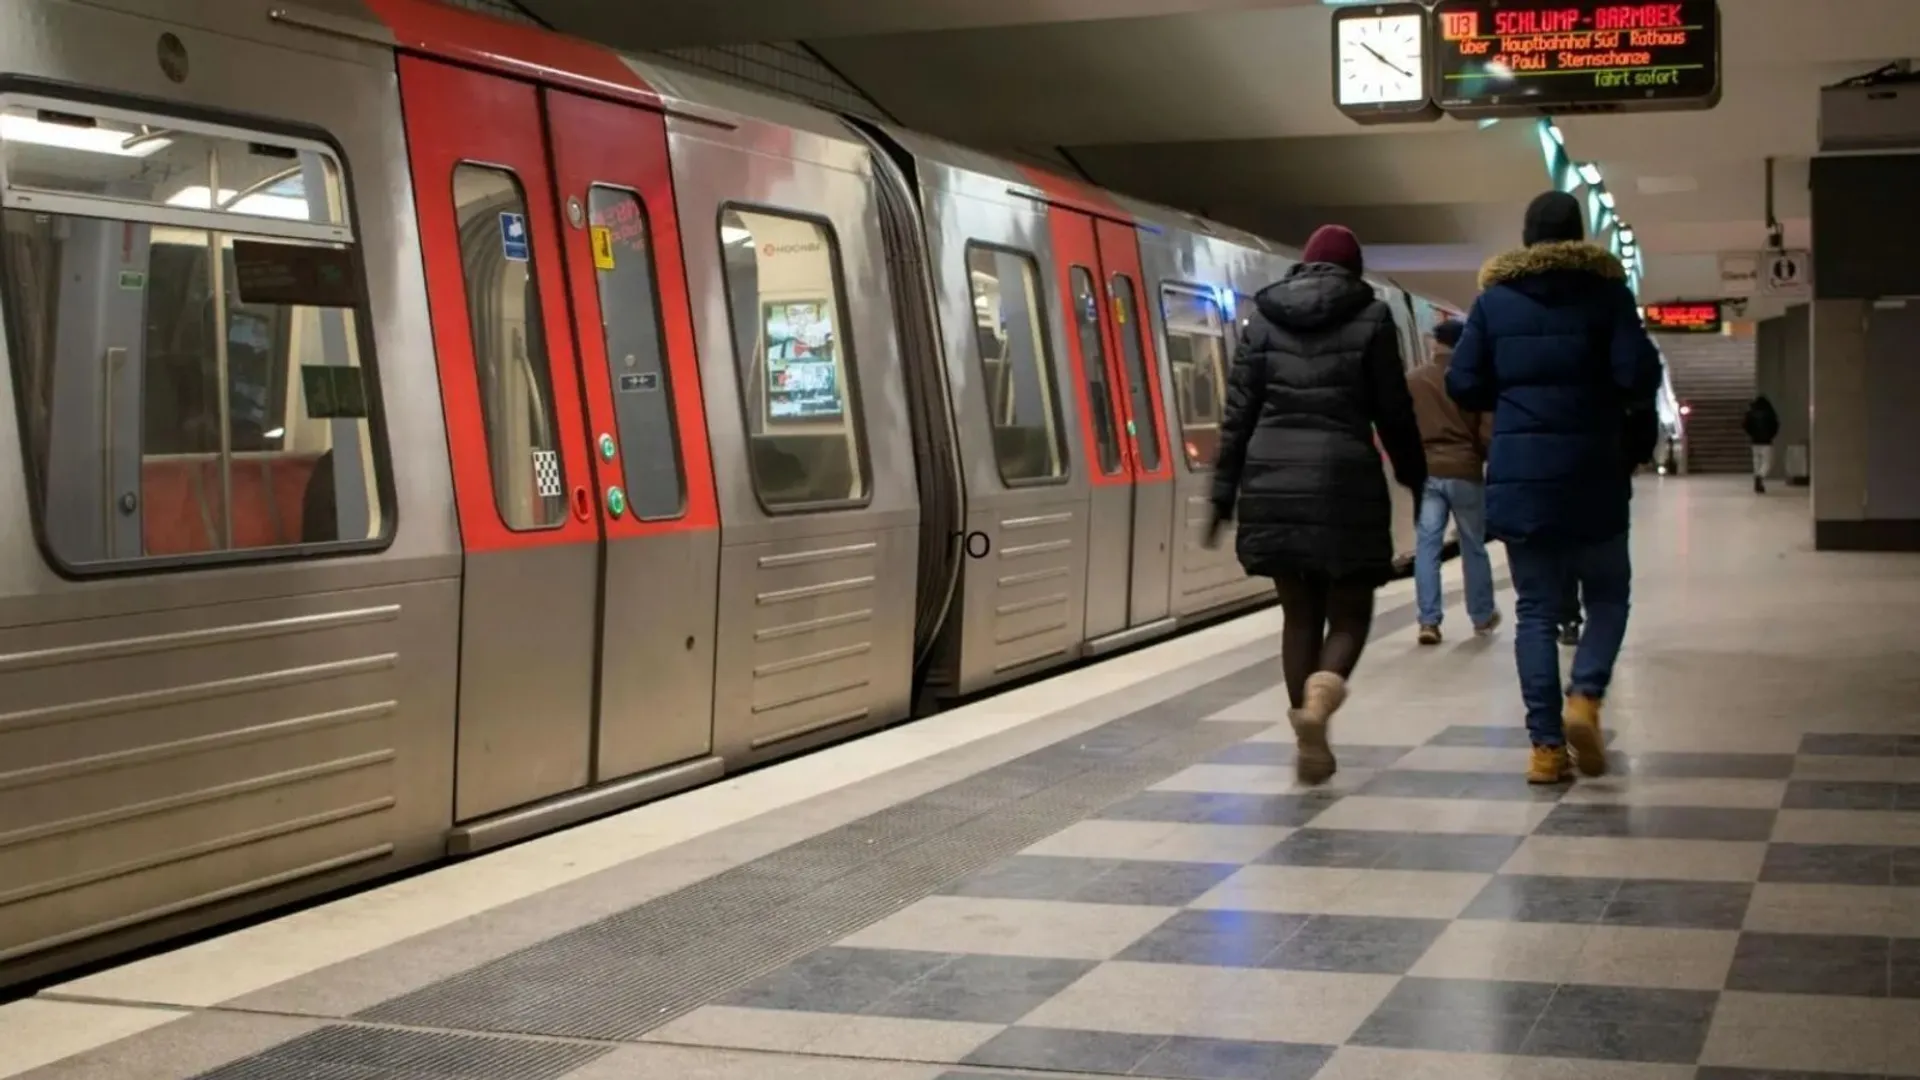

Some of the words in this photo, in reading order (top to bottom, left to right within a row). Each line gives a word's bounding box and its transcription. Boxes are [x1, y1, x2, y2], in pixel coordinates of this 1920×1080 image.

[1449, 15, 1471, 36] U3
[1459, 38, 1491, 55] über
[1501, 33, 1592, 54] Hauptbahnhof
[1593, 31, 1619, 49] Süd
[1630, 29, 1685, 46] Rathaus
[1511, 53, 1546, 70] Pauli
[1558, 49, 1650, 68] Sternschanze
[1634, 68, 1678, 85] sofort
